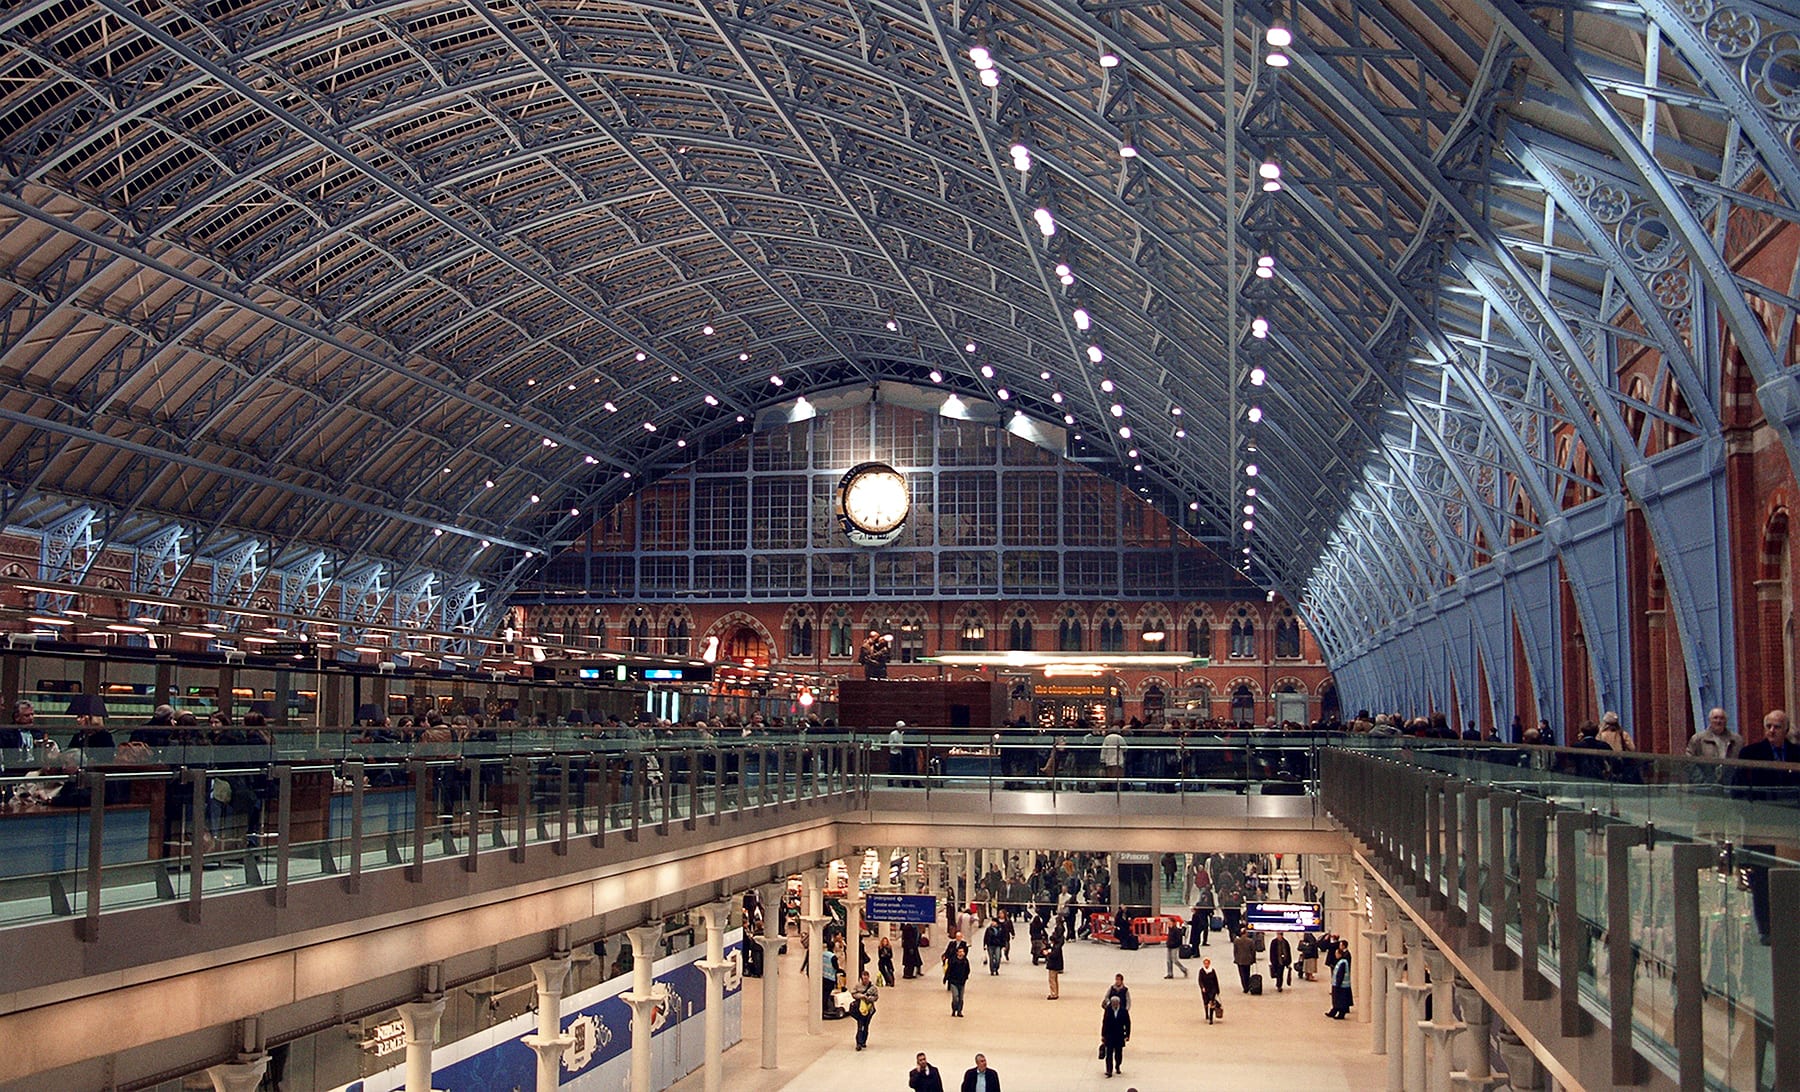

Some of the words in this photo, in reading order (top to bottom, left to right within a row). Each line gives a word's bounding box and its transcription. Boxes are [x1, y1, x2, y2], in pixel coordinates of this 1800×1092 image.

[1035, 685, 1047, 694] the
[1048, 685, 1091, 695] champagne
[1092, 685, 1105, 694] bar
